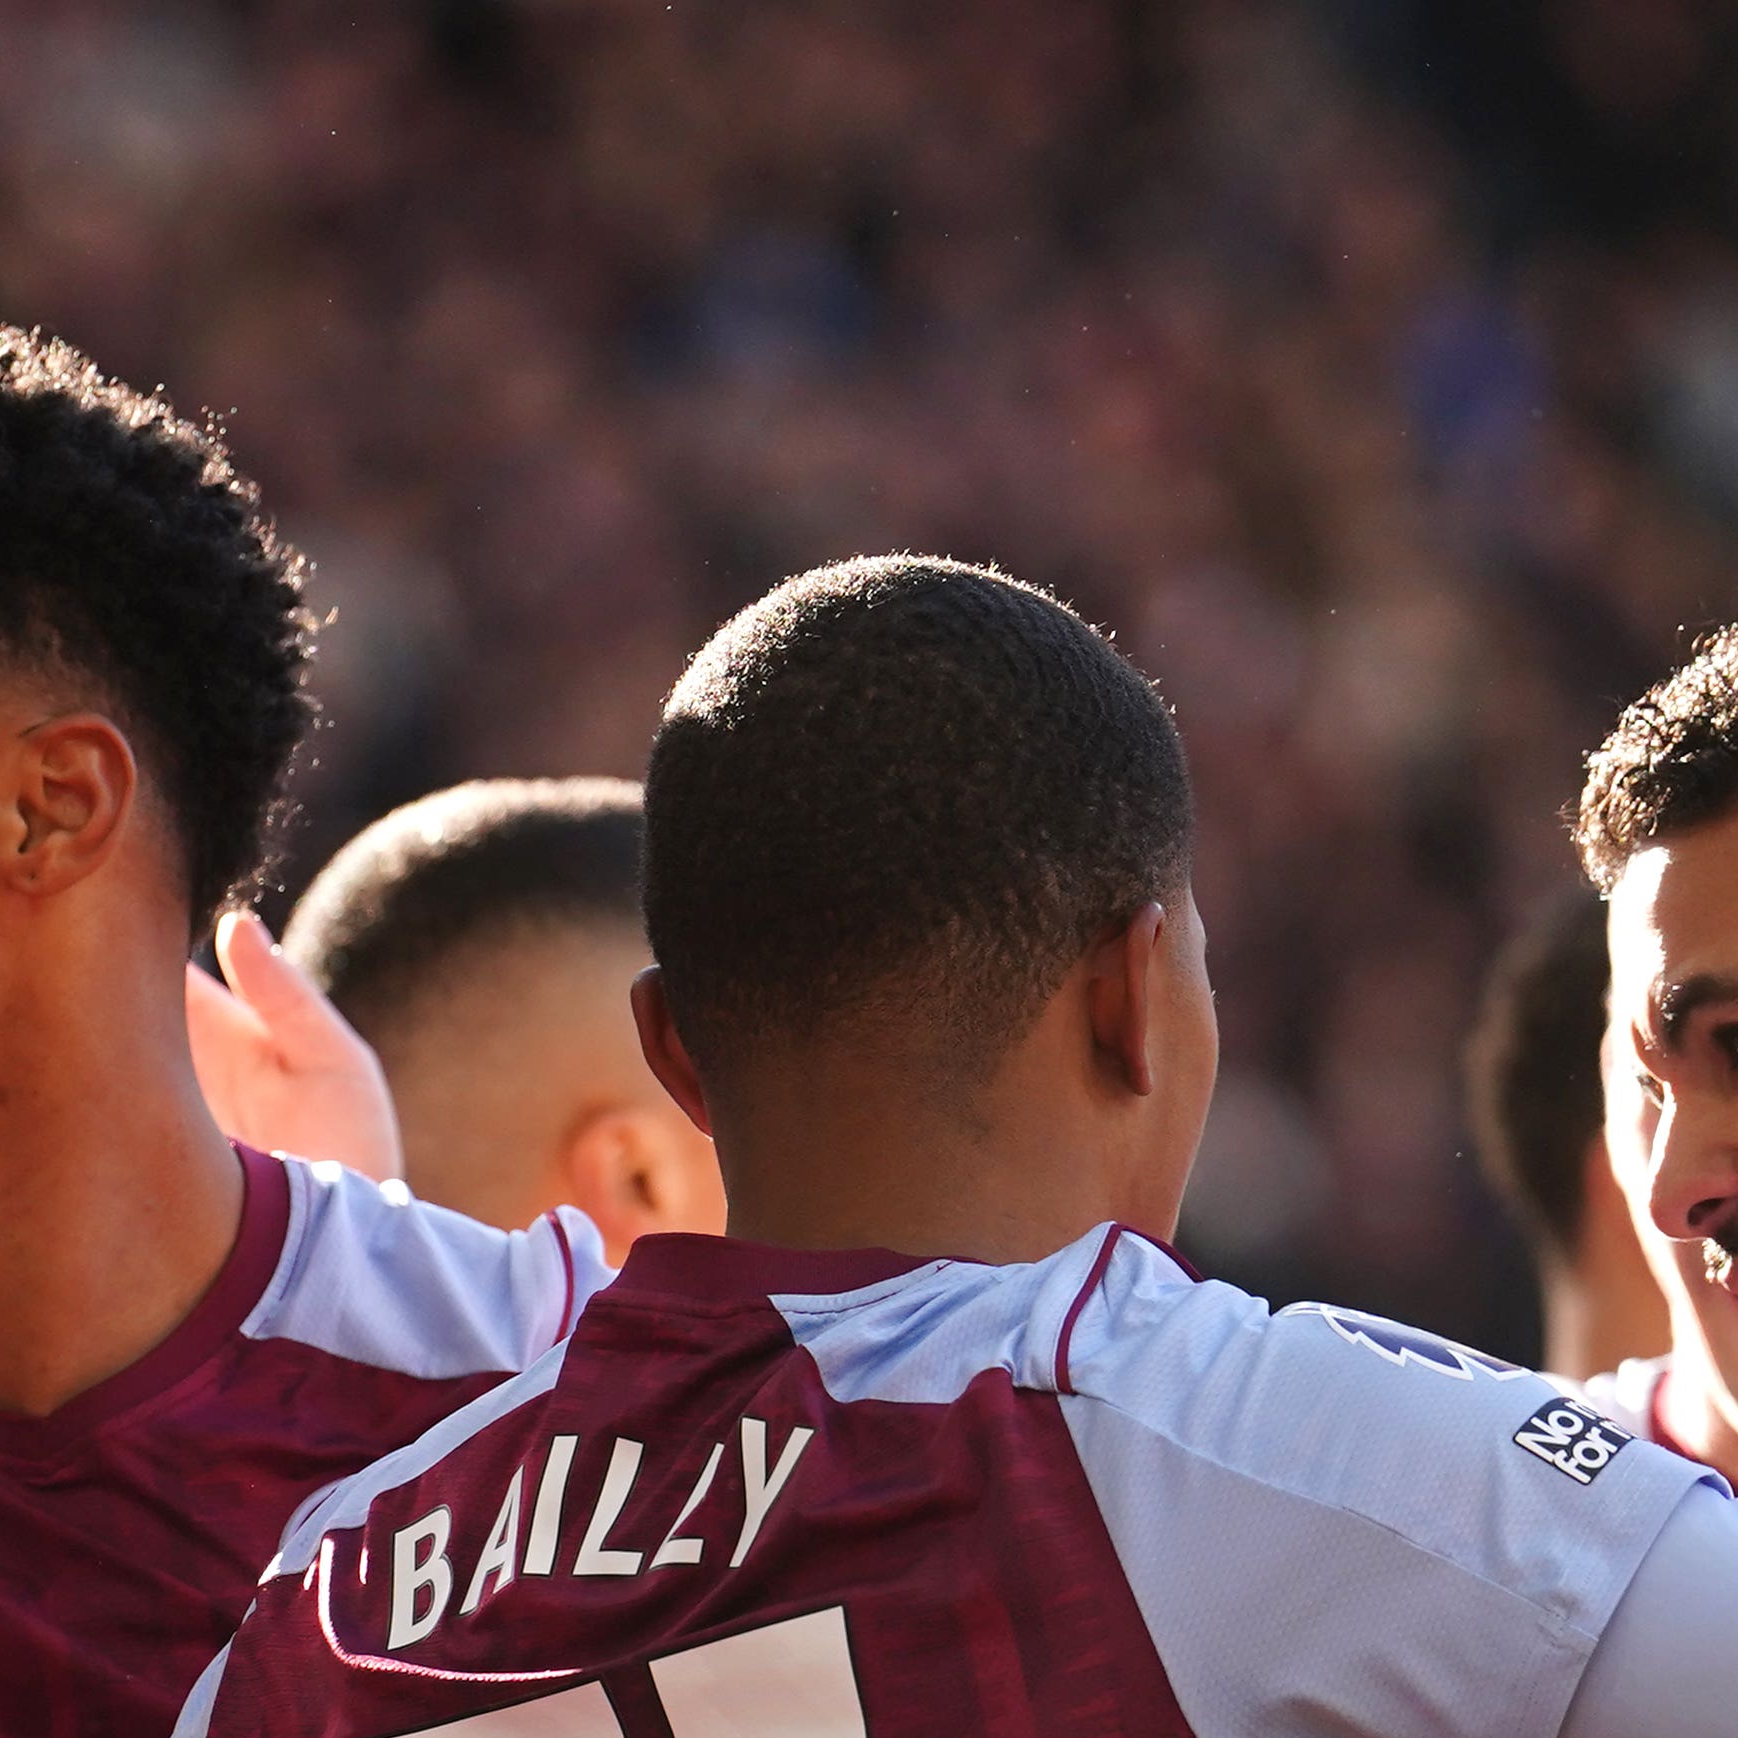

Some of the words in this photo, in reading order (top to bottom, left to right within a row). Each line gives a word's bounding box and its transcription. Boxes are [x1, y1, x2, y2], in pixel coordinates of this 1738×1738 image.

[1514, 1409, 1585, 1464] No
[1553, 1426, 1619, 1484] for
[387, 1416, 816, 1651] BAILLY
